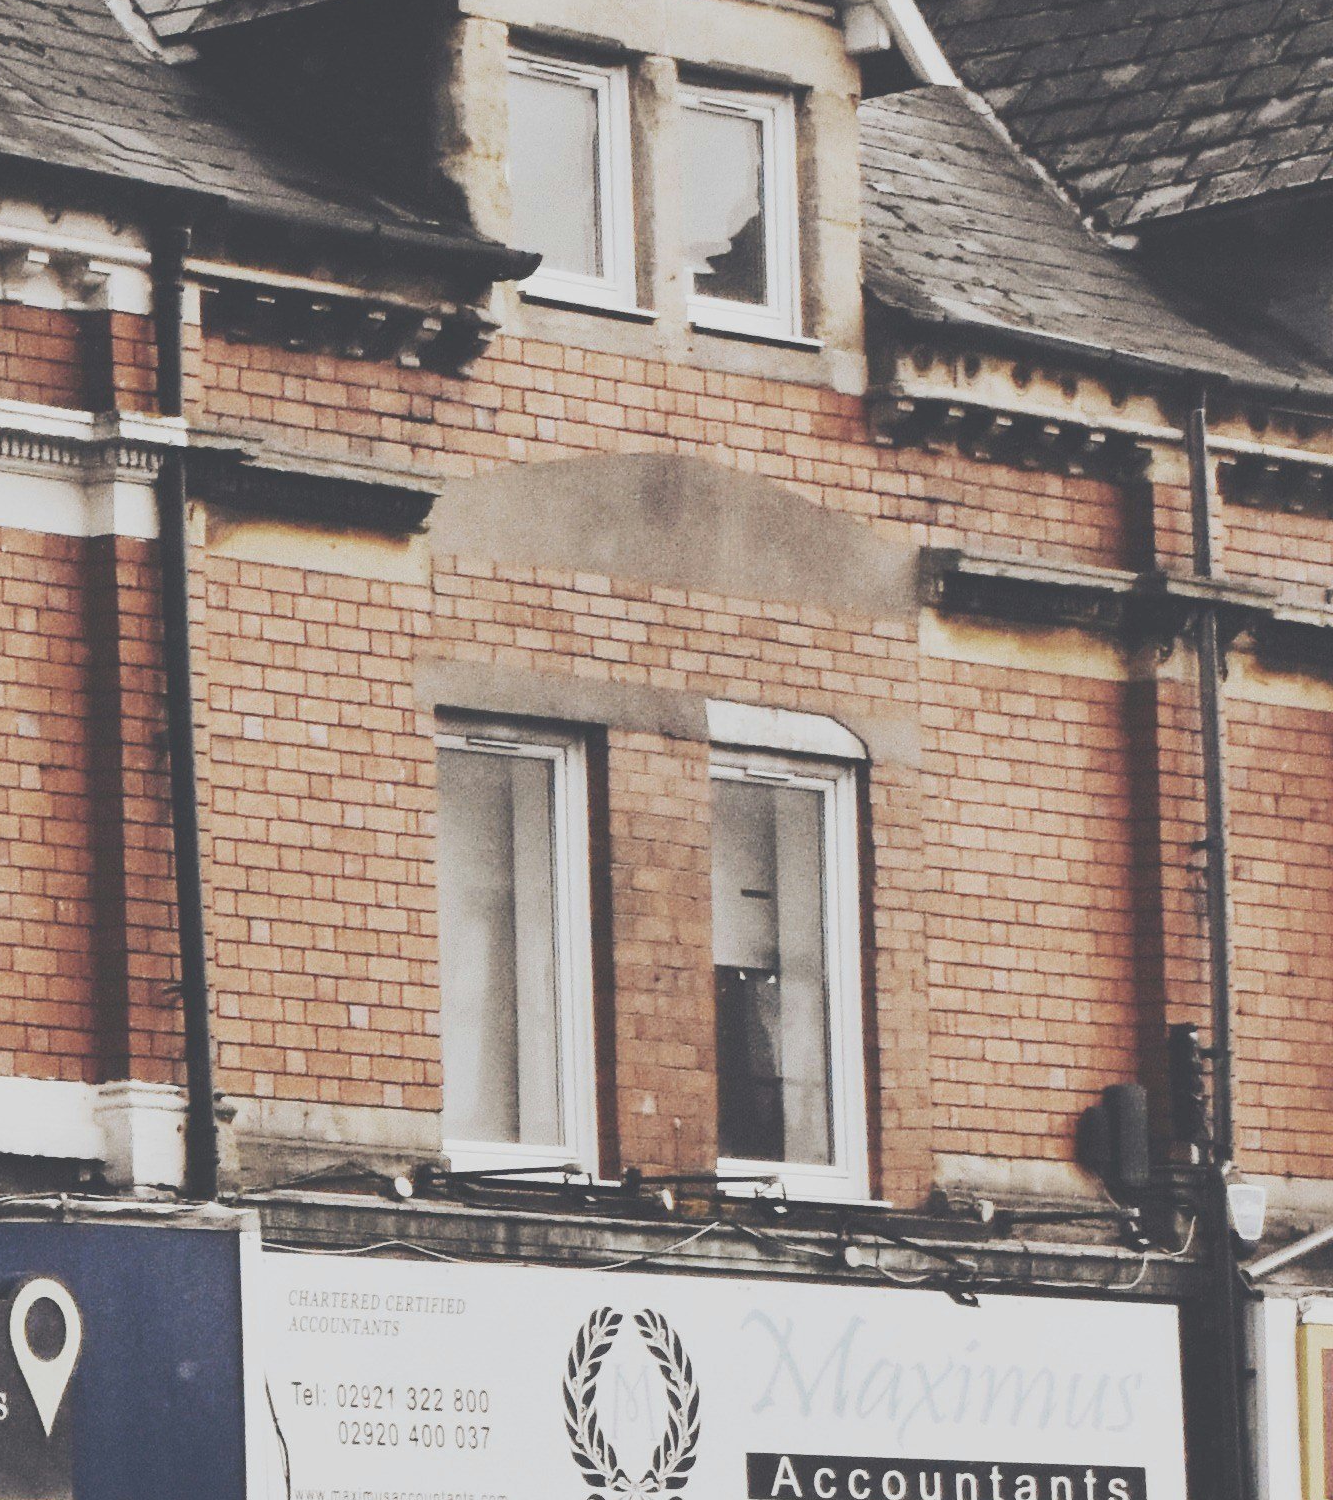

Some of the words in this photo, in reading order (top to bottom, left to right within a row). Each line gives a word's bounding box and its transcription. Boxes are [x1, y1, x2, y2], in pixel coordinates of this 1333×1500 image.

[288, 1289, 380, 1311] CHARTERED
[385, 1294, 466, 1315] CERTIFIED
[288, 1315, 401, 1337] ACCOUNTANTS
[739, 1307, 1144, 1448] Maximus
[291, 1381, 327, 1407] Tel:
[336, 1383, 395, 1410] 02921
[407, 1386, 444, 1412] 322
[453, 1388, 490, 1414] 800
[338, 1420, 399, 1446] 02920
[408, 1423, 446, 1448] 400
[455, 1425, 491, 1450] 037
